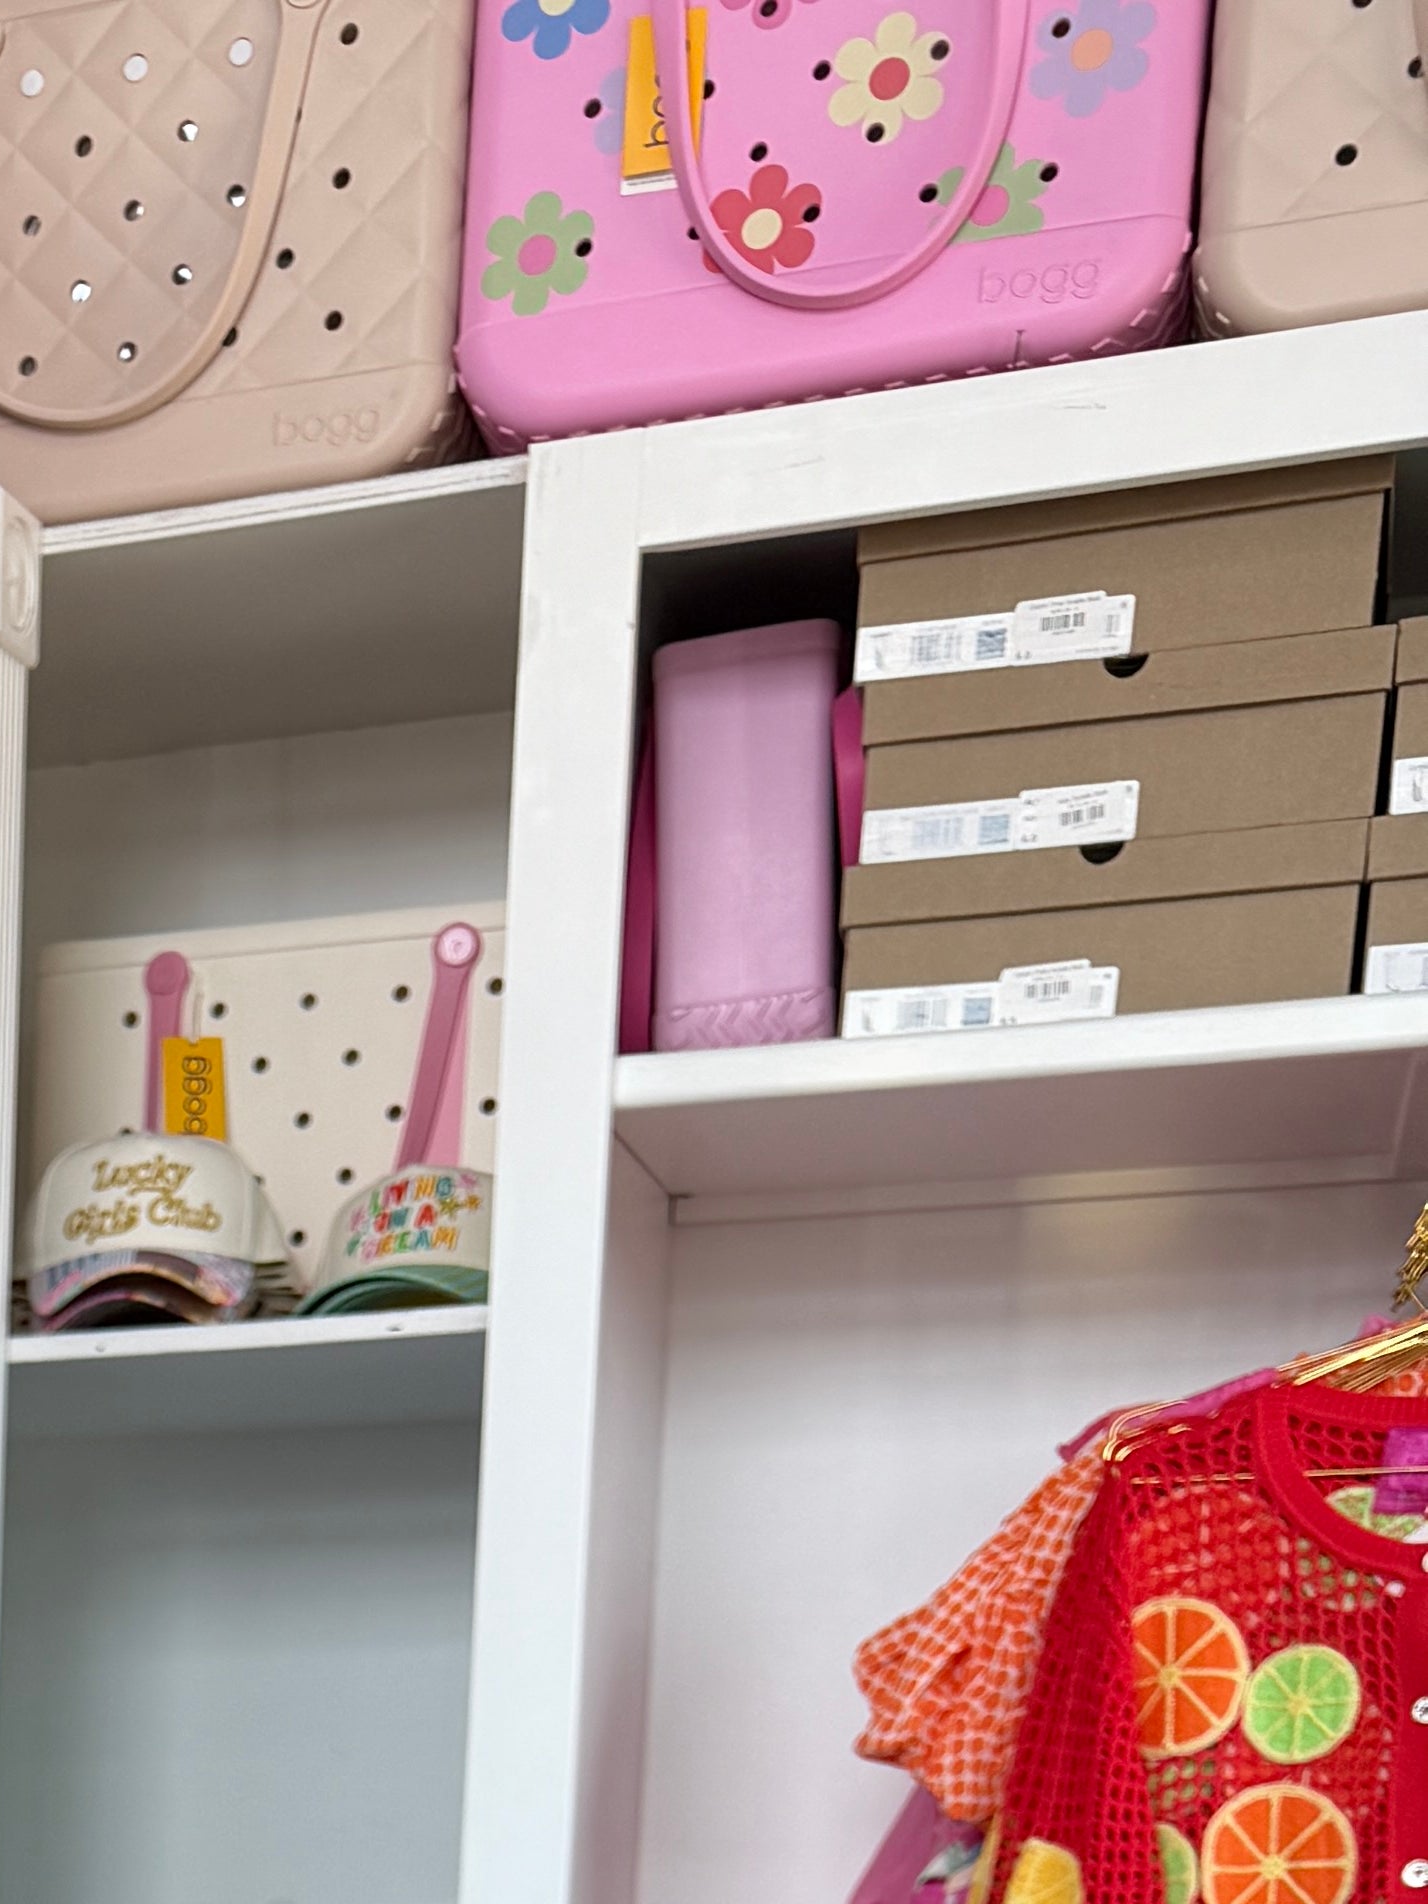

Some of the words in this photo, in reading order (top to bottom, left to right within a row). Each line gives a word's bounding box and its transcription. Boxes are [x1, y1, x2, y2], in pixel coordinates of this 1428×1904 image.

[977, 258, 1103, 305] bogg
[270, 402, 382, 448] bogg
[92, 1155, 195, 1196] Lucky
[62, 1200, 141, 1245] Girls
[147, 1195, 224, 1232] Club
